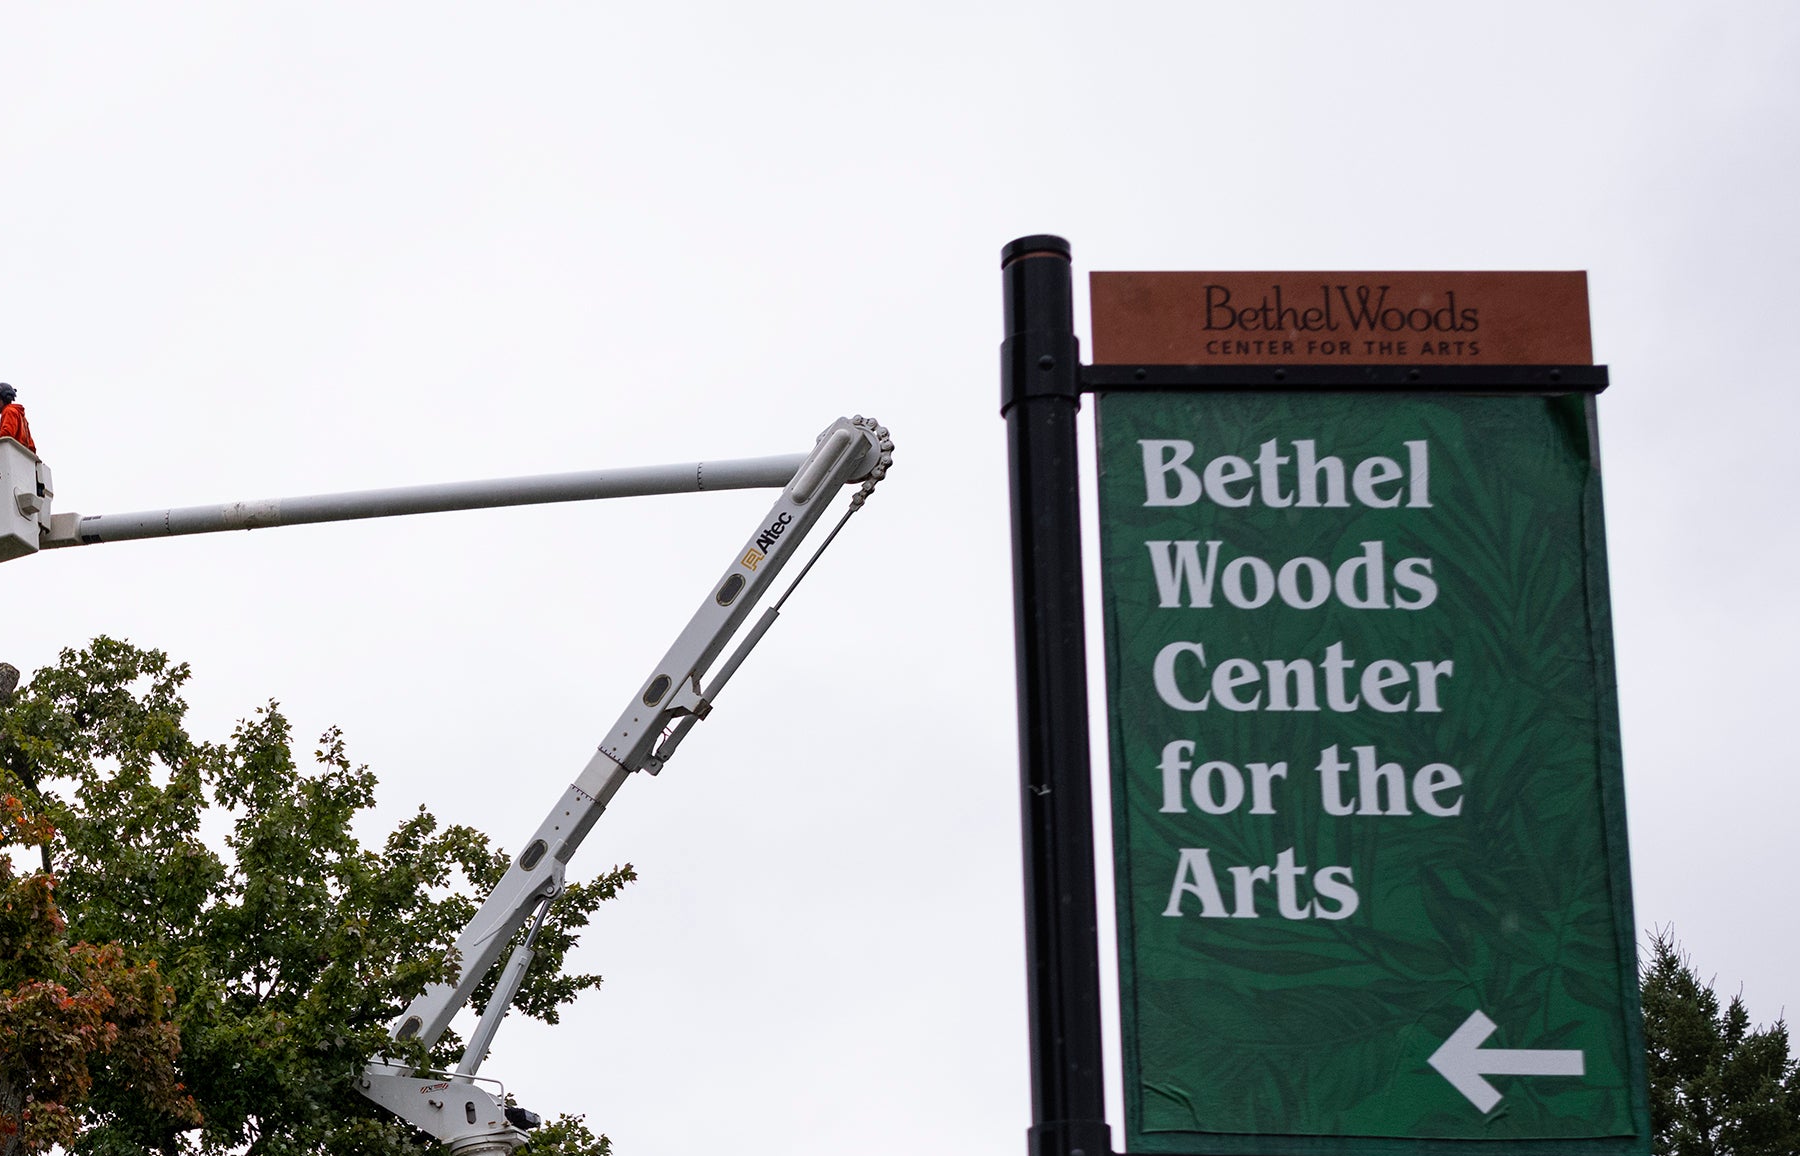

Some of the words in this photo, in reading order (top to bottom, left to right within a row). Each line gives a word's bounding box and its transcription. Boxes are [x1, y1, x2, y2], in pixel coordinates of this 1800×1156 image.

[1206, 340, 1294, 355] CENTER
[1308, 340, 1352, 355] FOR
[1364, 340, 1407, 355] THE
[1420, 340, 1480, 356] ARTS
[1137, 438, 1434, 509] Bethel
[756, 512, 792, 555] Altec
[1145, 540, 1438, 611] Woods
[1153, 641, 1453, 713] Center
[1156, 740, 1288, 814] for
[1315, 744, 1464, 817] the
[1162, 847, 1360, 920] Arts
